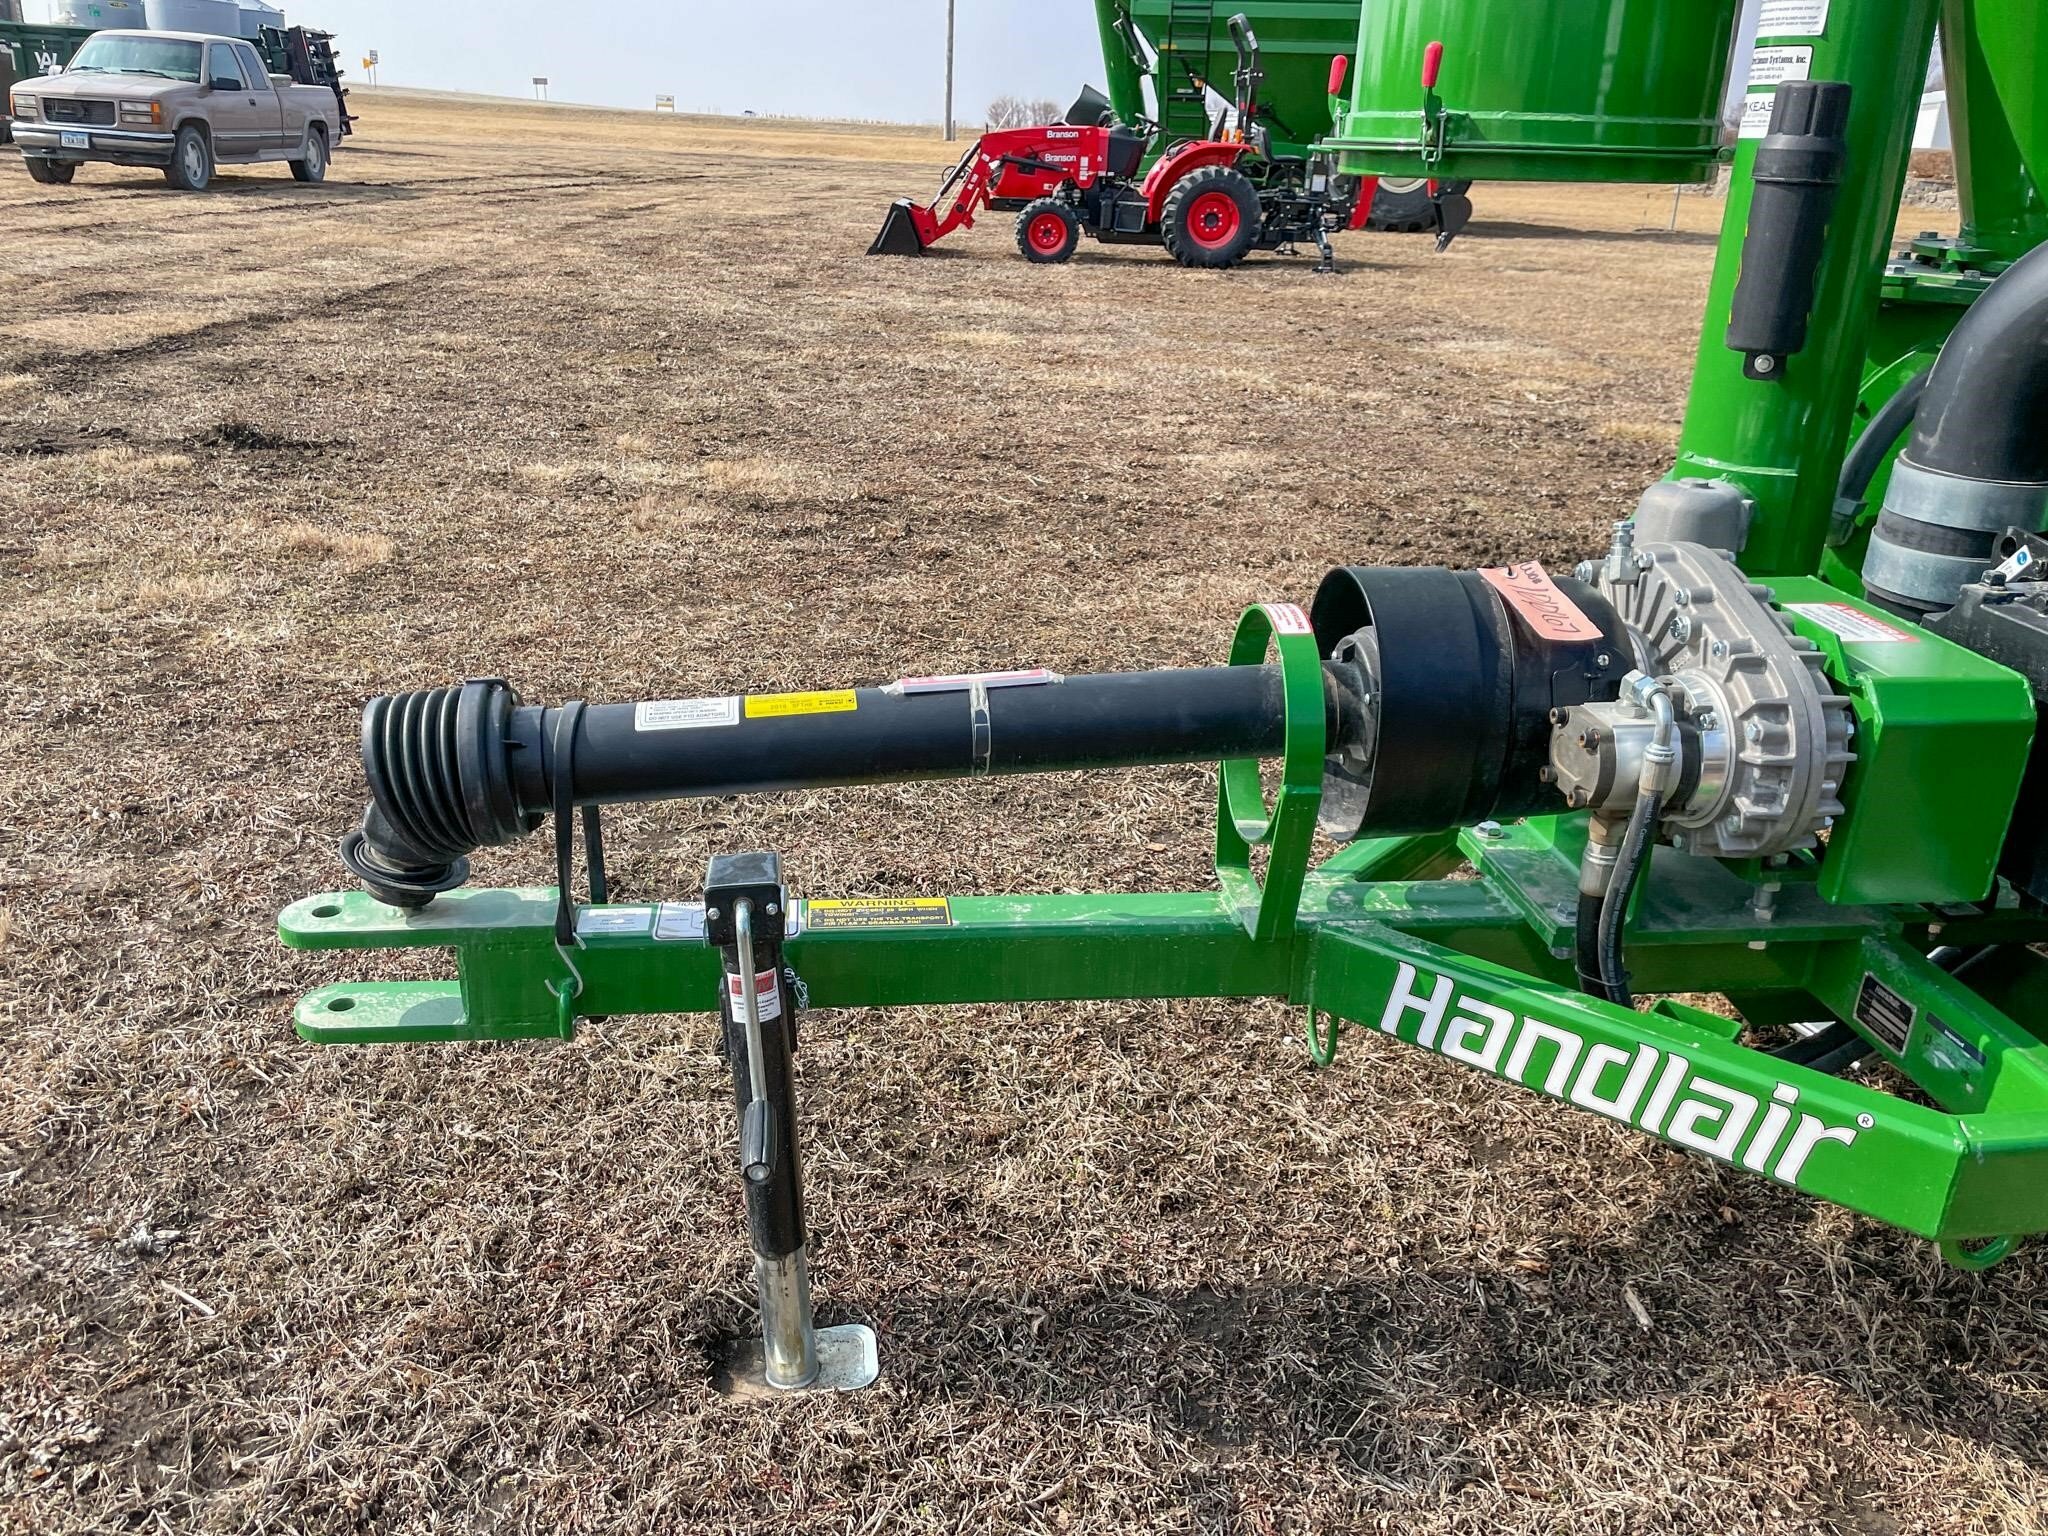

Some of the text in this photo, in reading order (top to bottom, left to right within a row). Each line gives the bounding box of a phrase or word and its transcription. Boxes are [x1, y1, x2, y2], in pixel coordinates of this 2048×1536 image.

[1046, 129, 1079, 139] Branson
[1044, 152, 1077, 162] Branson
[840, 899, 916, 907] WARNING
[1380, 961, 1858, 1185] Handlair
